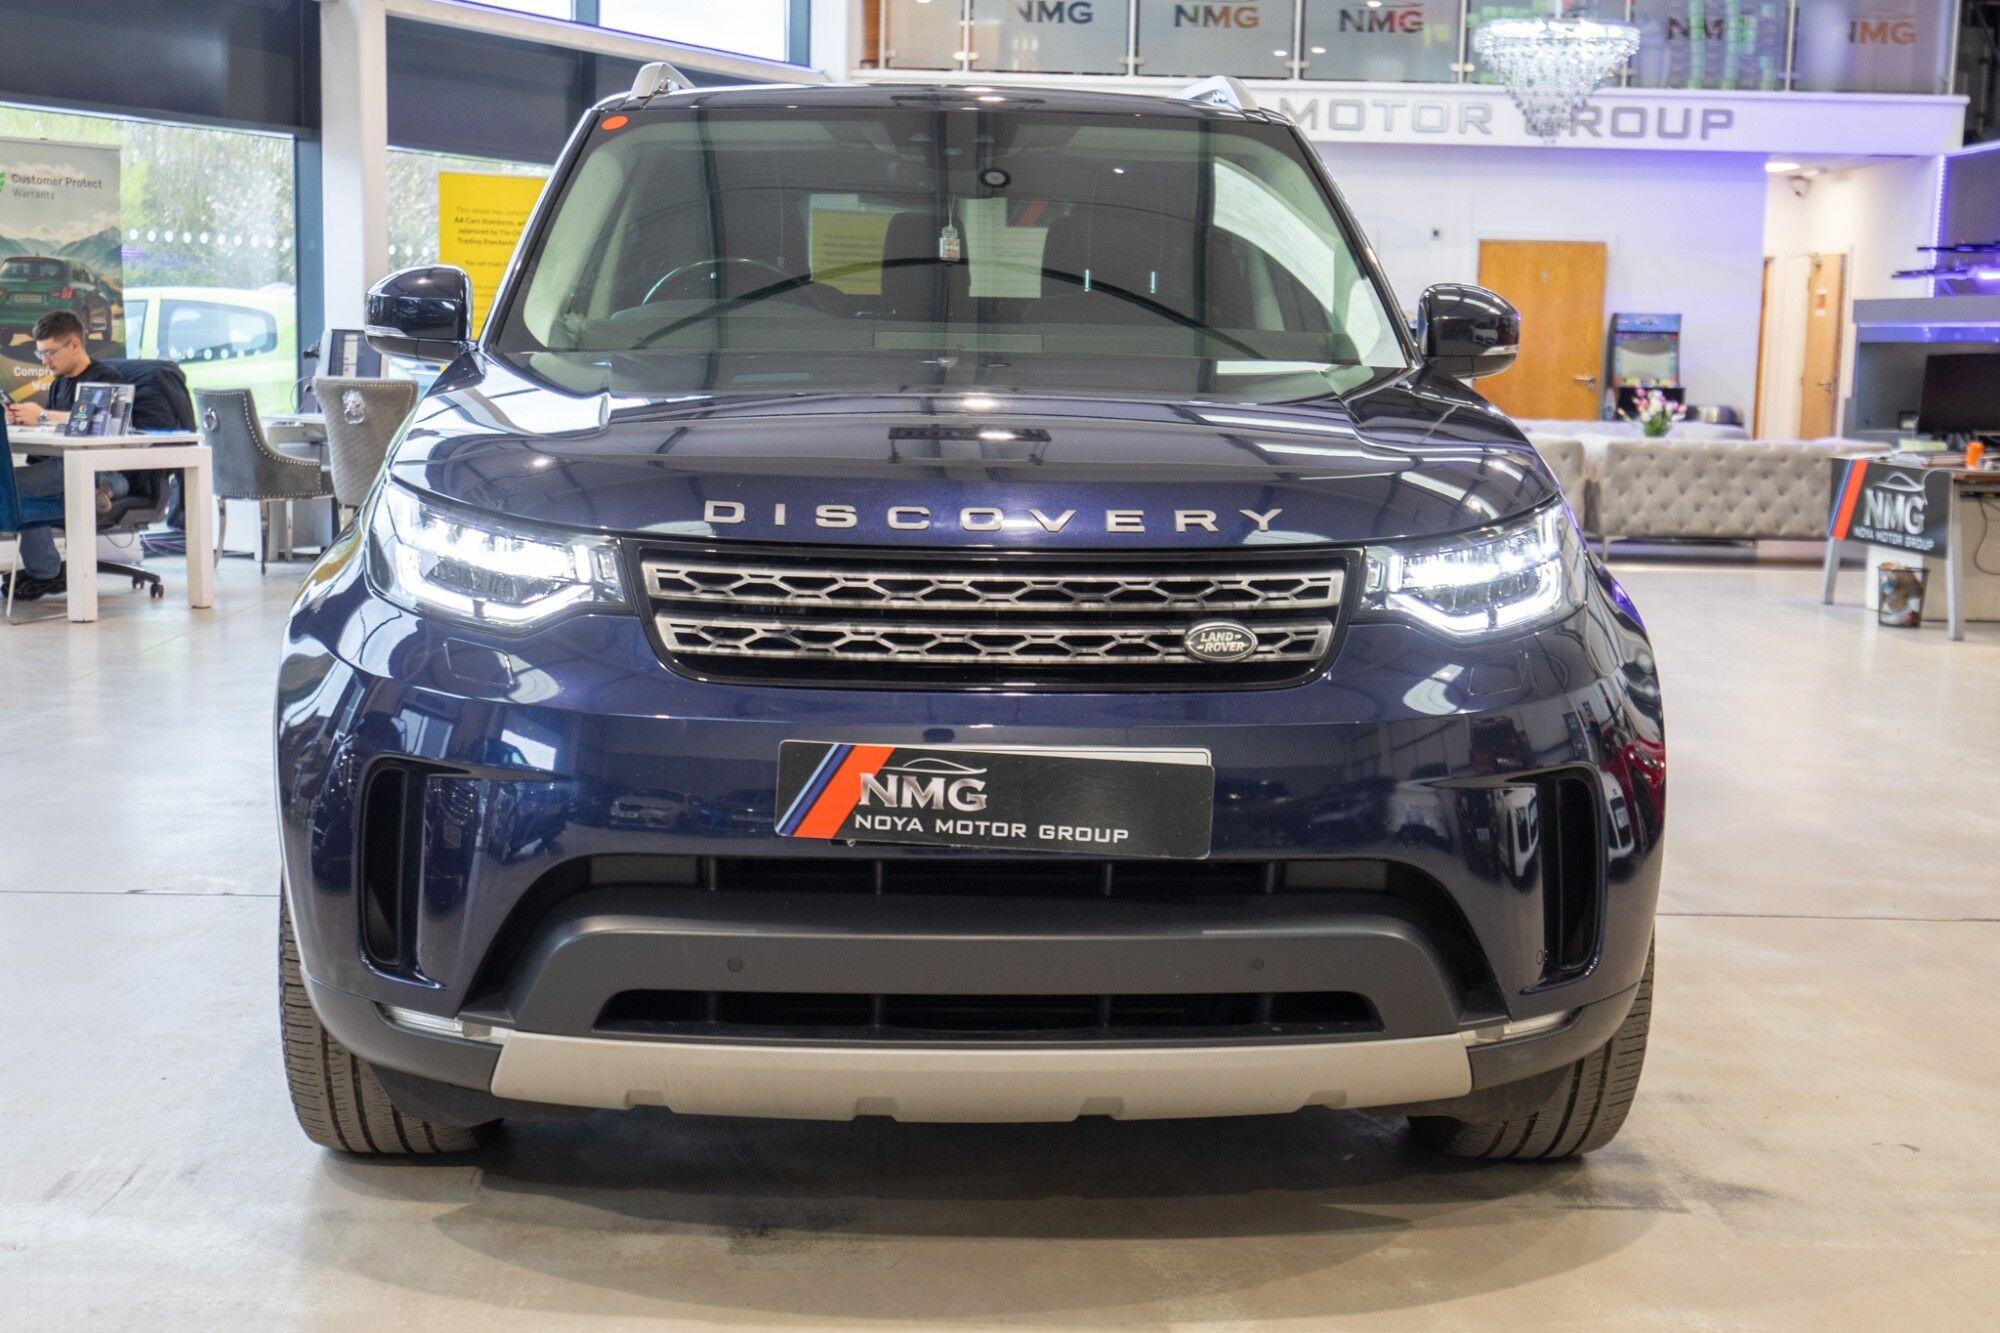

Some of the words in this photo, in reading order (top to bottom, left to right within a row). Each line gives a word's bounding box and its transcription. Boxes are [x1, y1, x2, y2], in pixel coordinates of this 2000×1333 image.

[1174, 5, 1260, 28] NMG
[1339, 9, 1424, 33] NMG
[1280, 97, 1493, 135] MOTOR
[11, 173, 62, 186] Customer
[65, 177, 102, 189] Protect
[13, 188, 55, 201] Warranty
[704, 500, 1283, 533] DISCOVERY
[1864, 487, 1925, 535] NMG
[1853, 526, 1874, 539] NOYA
[1876, 530, 1904, 546] MOTOR
[1904, 536, 1935, 551] GROUP
[858, 772, 987, 812] NMG
[854, 814, 924, 832] NOYA
[935, 819, 1027, 838] MOTOR
[1038, 824, 1129, 844] GROUP
